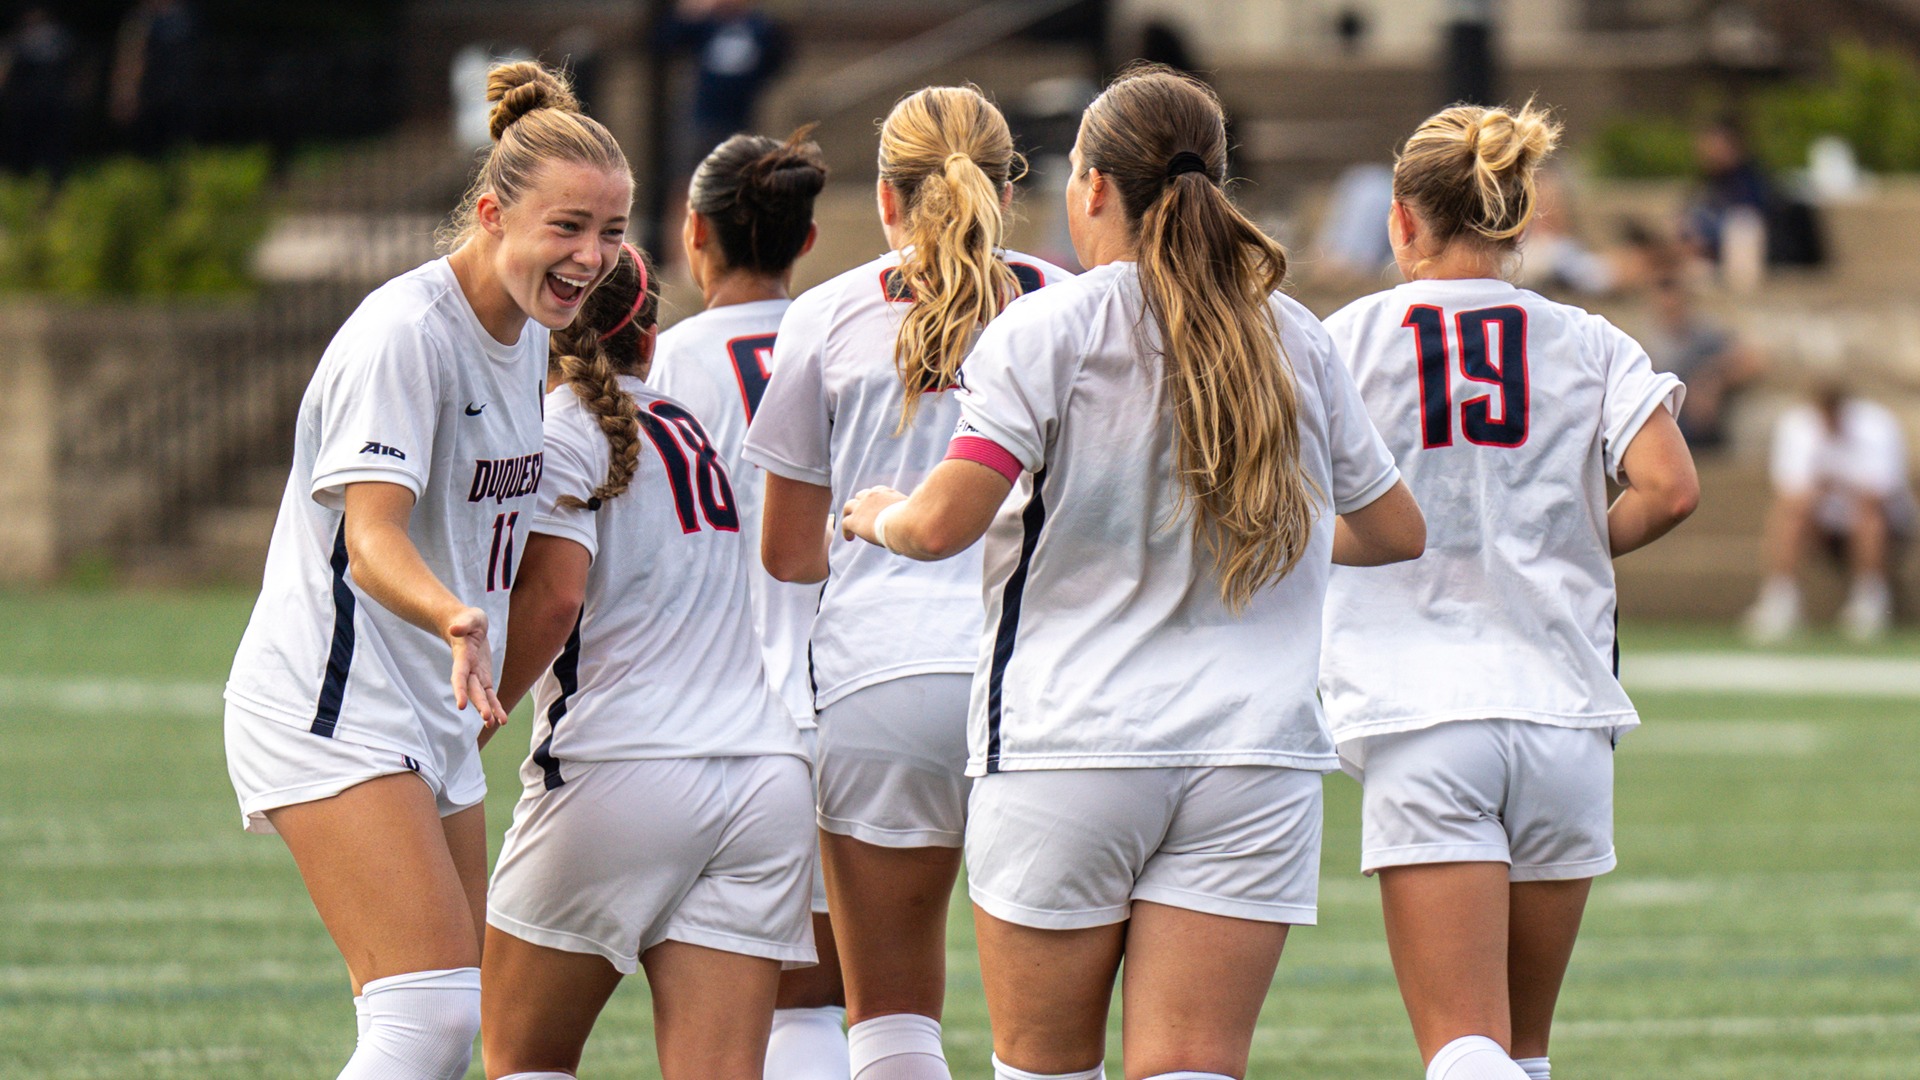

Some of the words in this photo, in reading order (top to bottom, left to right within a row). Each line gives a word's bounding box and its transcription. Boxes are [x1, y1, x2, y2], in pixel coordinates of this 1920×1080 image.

[1401, 303, 1530, 450] 19
[635, 400, 740, 534] 18
[486, 511, 519, 592] 11
